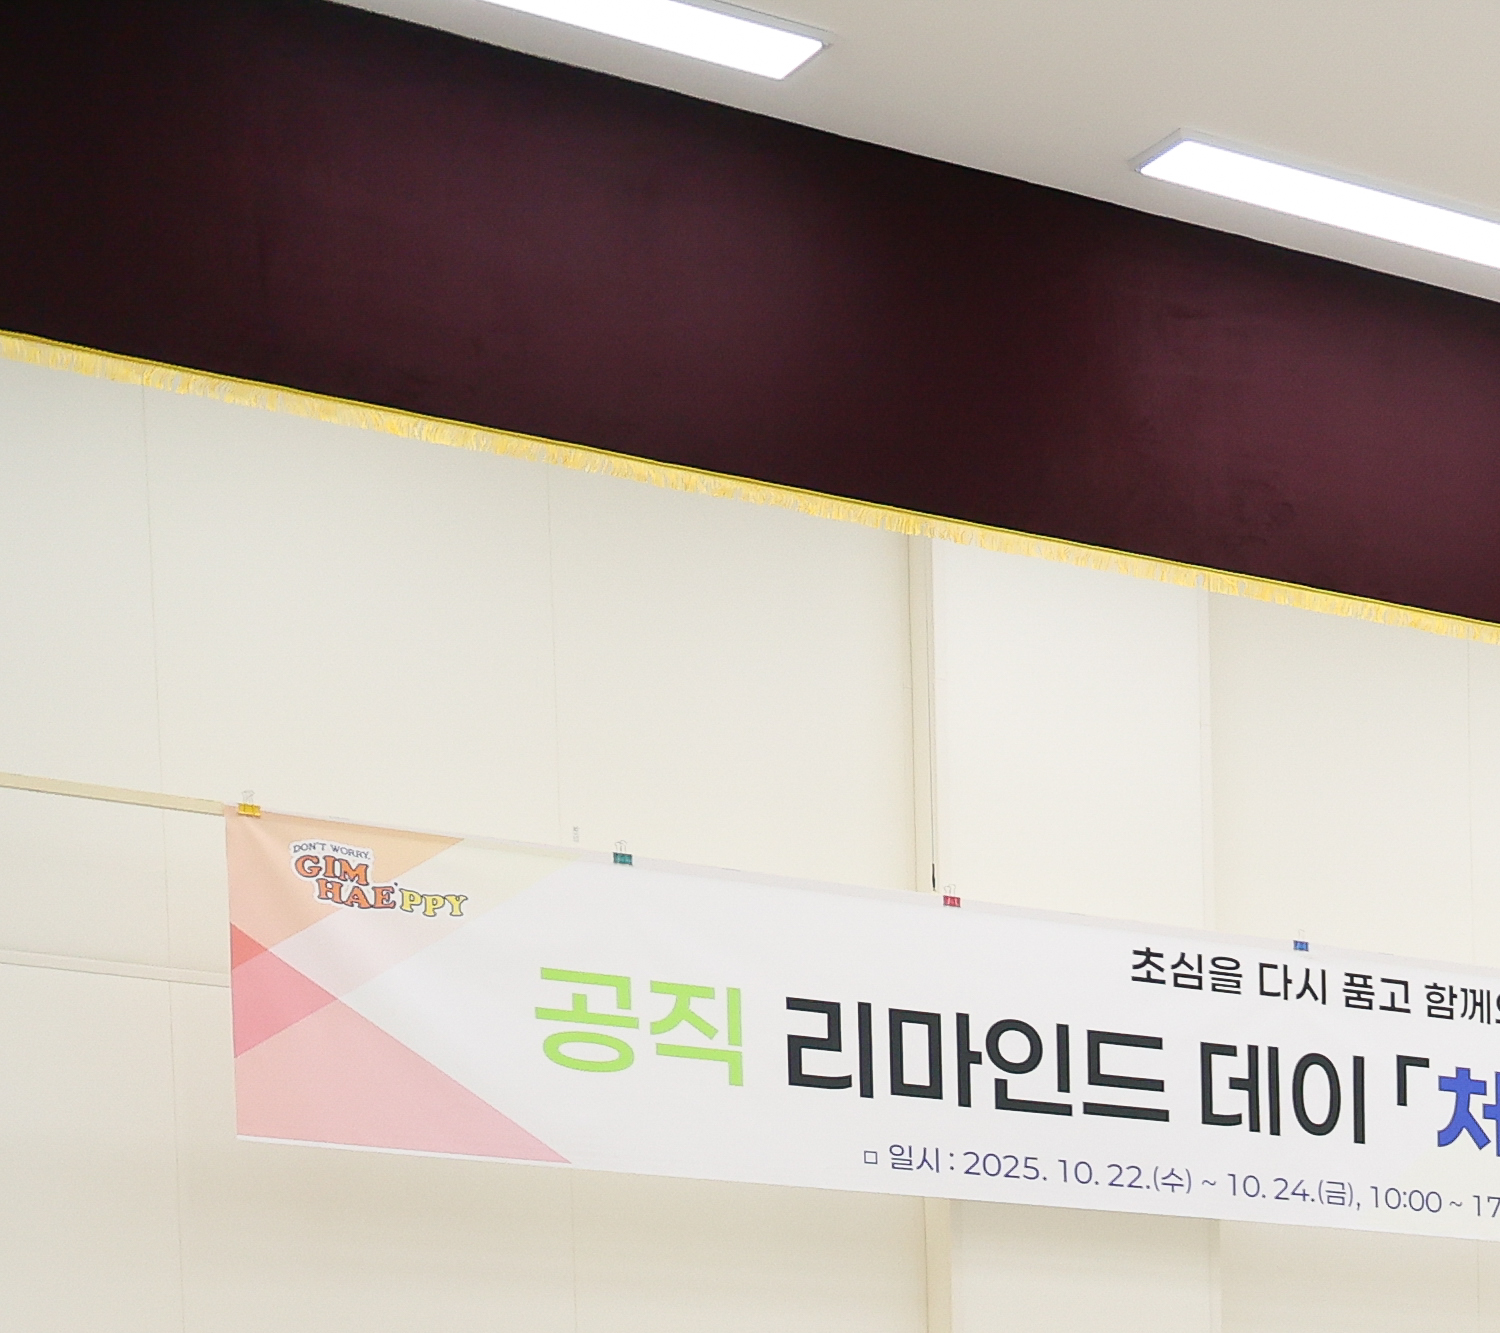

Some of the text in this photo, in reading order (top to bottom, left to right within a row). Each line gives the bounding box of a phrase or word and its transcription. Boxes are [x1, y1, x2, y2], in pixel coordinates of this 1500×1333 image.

[292, 842, 327, 854] DON'T
[294, 854, 369, 886] GIM
[1131, 947, 1243, 995] 초심을
[1259, 962, 1327, 1005] 다시
[1342, 972, 1412, 1015] 품고
[534, 966, 745, 1088] 공직
[785, 996, 1170, 1123] 리마인드
[1199, 1041, 1366, 1145] 데이
[889, 1144, 940, 1174] 일시
[963, 1151, 1047, 1182] 2025.
[1057, 1159, 1100, 1186] 10.
[1107, 1163, 1192, 1194] 22.(수)
[1227, 1173, 1266, 1199] 10.
[1370, 1186, 1443, 1214] 10:00
